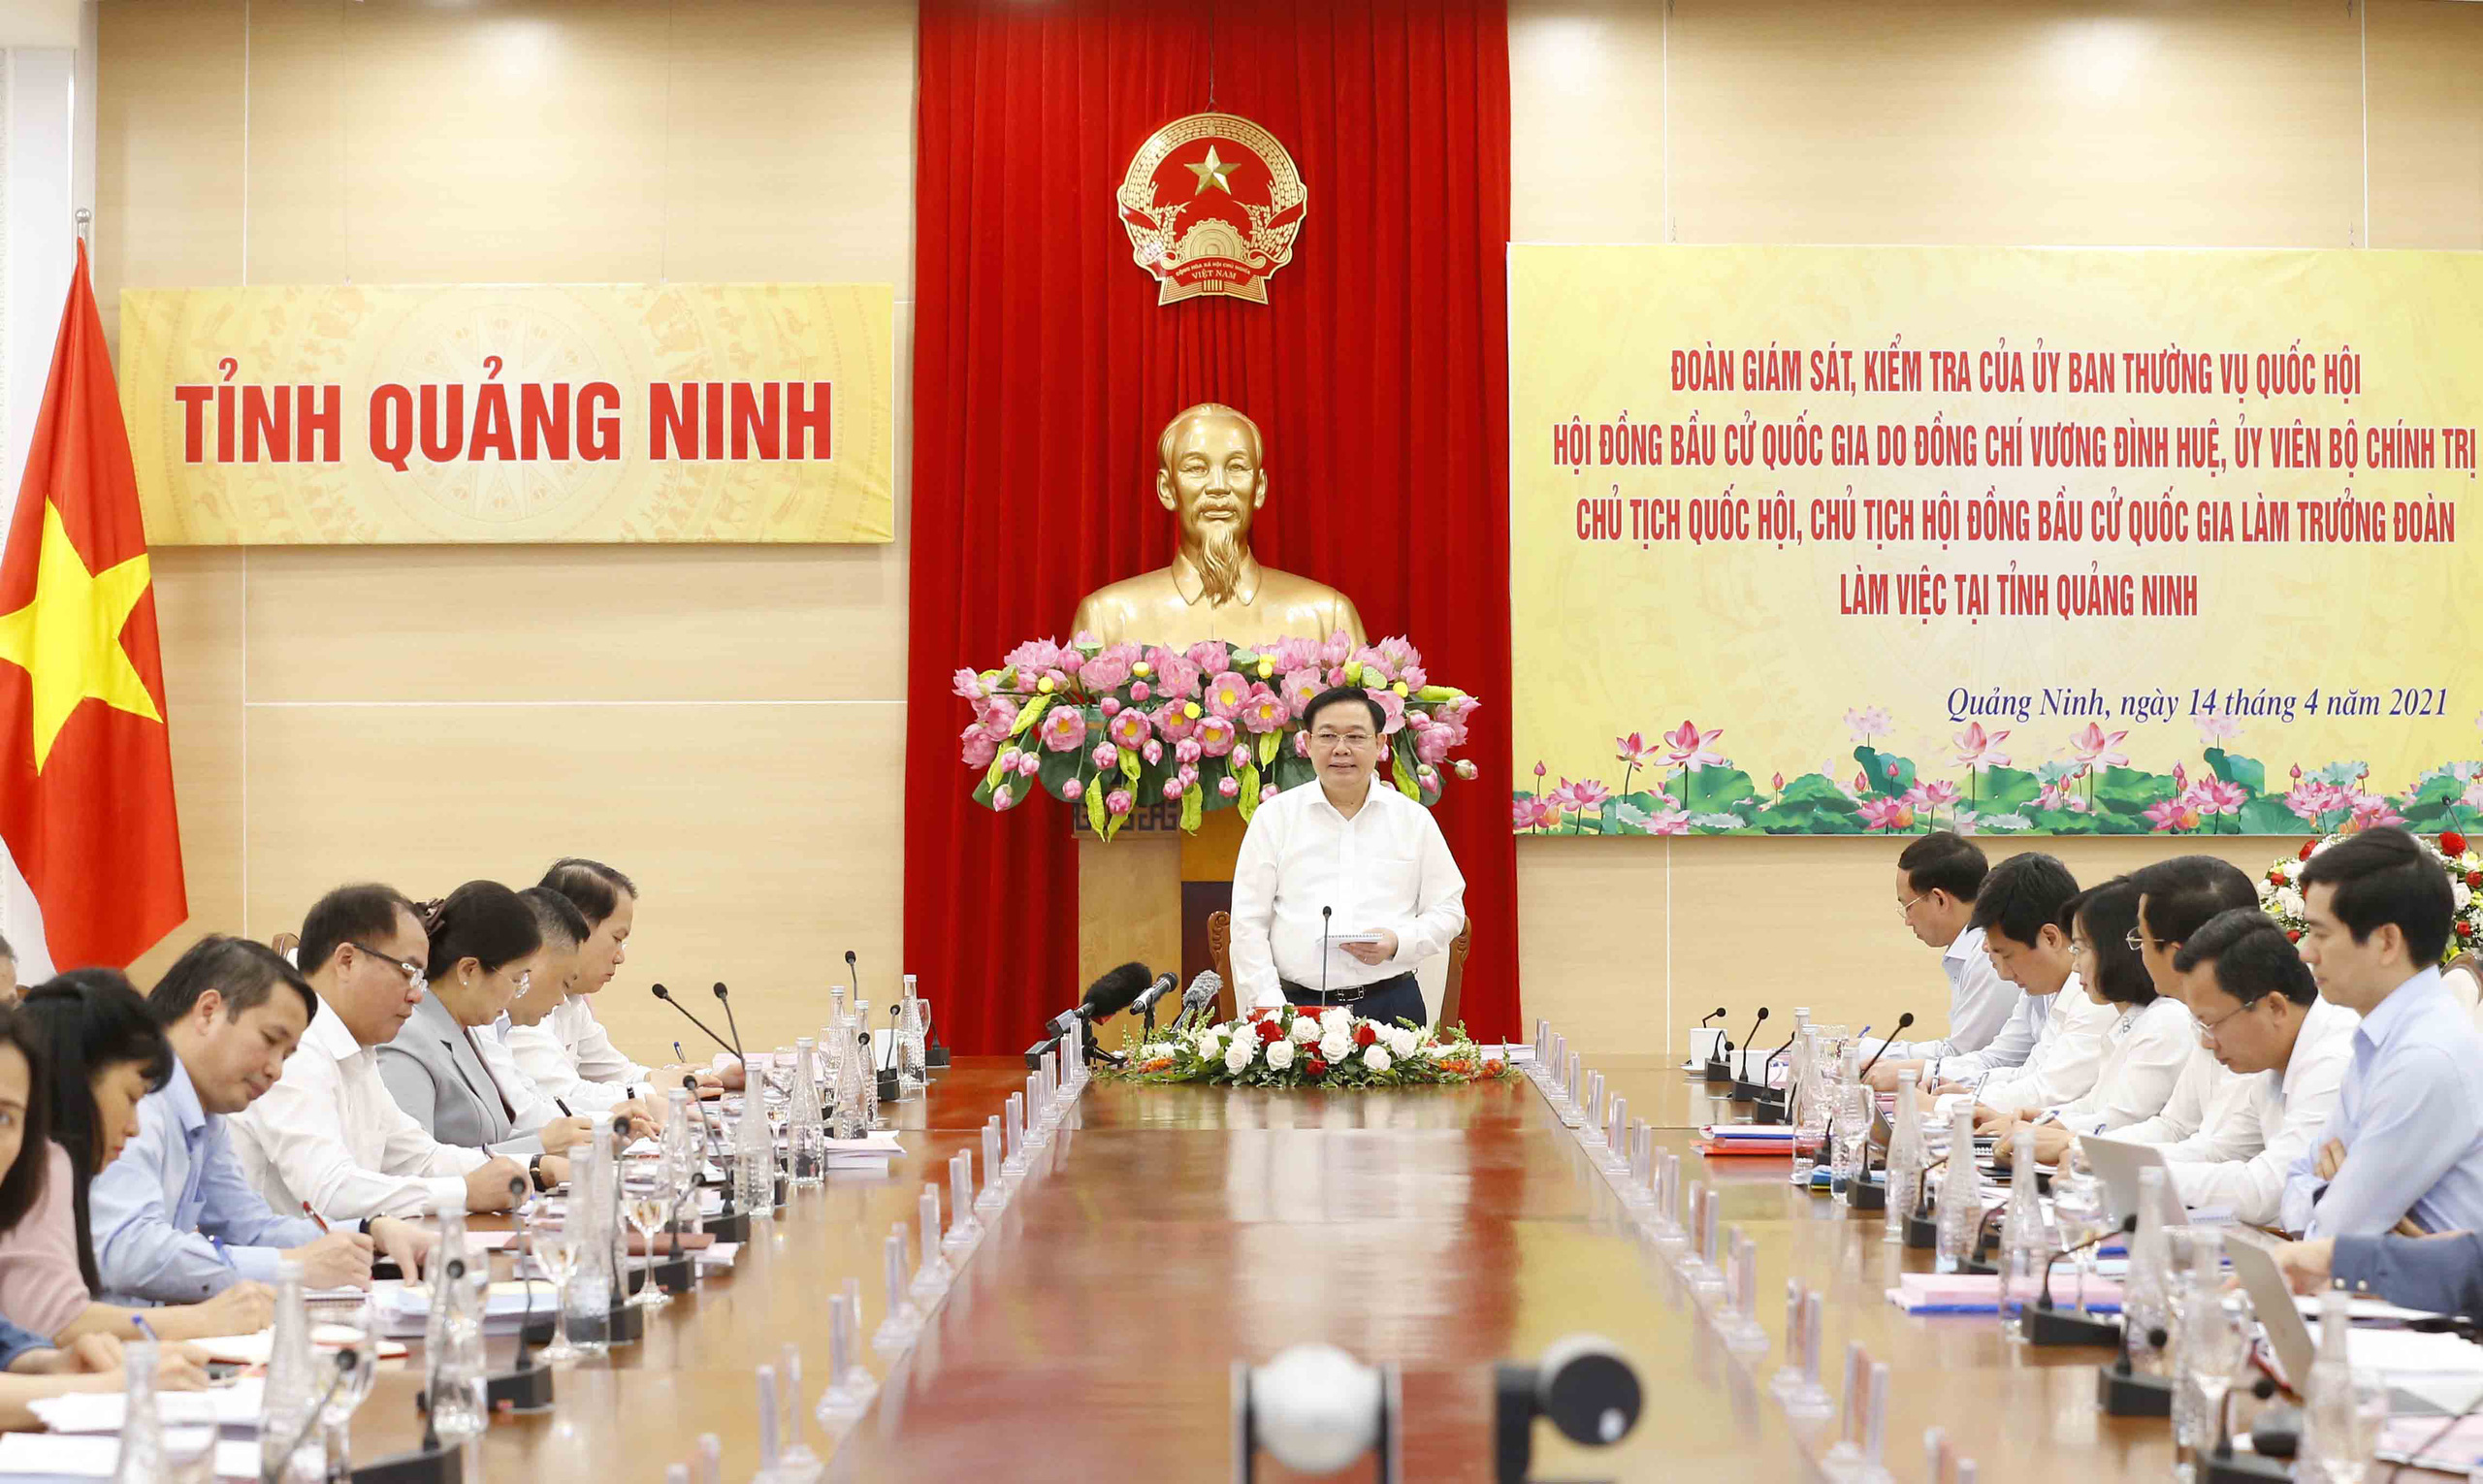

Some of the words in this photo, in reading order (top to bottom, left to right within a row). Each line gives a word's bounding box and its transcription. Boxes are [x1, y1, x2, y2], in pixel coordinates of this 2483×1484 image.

[1192, 269, 1213, 278] VIỆT
[1215, 270, 1237, 279] NAM
[1671, 341, 1735, 392] ĐOÀN
[1742, 341, 1802, 392] GIÁM
[1810, 342, 1856, 397] SÁT,
[1864, 333, 1922, 392] KIỂM
[1929, 350, 1972, 392] TRA
[1980, 337, 2025, 394] CỦA
[2032, 338, 2061, 394] ỦY
[2069, 352, 2115, 394] BAN
[2122, 342, 2212, 395] THƯỜNG
[2220, 352, 2248, 404] VỤ
[2256, 339, 2316, 399] QUỐC
[2324, 345, 2361, 404] HỘI
[174, 356, 341, 464] TỈNH
[370, 355, 622, 473] QUẢNG
[648, 381, 832, 461] NINH
[1554, 415, 1592, 475] HỘI
[1599, 410, 1662, 467] ĐỒNG
[1670, 410, 1717, 467] BẦU
[1724, 410, 1757, 467] CỬ
[1762, 409, 1823, 470] QUỐC
[1831, 424, 1870, 467] GIA
[1877, 424, 1907, 468] DO
[1915, 411, 1978, 467] ĐỒNG
[1984, 417, 2023, 468] CHÍ
[2030, 422, 2107, 468] VƯƠNG
[2113, 418, 2169, 468] ĐÌNH
[2176, 418, 2227, 478] HUỆ,
[2235, 413, 2263, 468] ỦY
[2270, 419, 2322, 468] VIÊN
[2329, 419, 2359, 478] BỘ
[2367, 419, 2435, 469] CHÍNH
[2442, 427, 2476, 478] TRỊ
[1576, 484, 1623, 541] CHỦ
[1629, 499, 1681, 550] TỊCH
[1689, 483, 1750, 545] QUỐC
[1757, 490, 1803, 550] HỘI,
[1810, 484, 1856, 541] CHỦ
[1863, 499, 1915, 550] TỊCH
[1921, 490, 1960, 550] HỘI
[1967, 485, 2030, 542] ĐỒNG
[2038, 485, 2083, 542] BẦU
[2091, 486, 2124, 542] CỬ
[2128, 486, 2189, 548] QUỐC
[2197, 500, 2235, 543] GIA
[2241, 492, 2290, 543] LÀM
[2297, 488, 2387, 543] TRƯỞNG
[2393, 493, 2456, 543] ĐOÀN
[1840, 565, 1889, 616] LÀM
[1896, 565, 1948, 626] VIỆC
[1953, 573, 1989, 626] TẠI
[1996, 560, 2049, 616] TỈNH
[2056, 560, 2135, 621] QUẢNG
[2142, 574, 2198, 617] NINH
[1947, 686, 2032, 724] Quảng
[2038, 688, 2112, 720] Ninh,
[2119, 688, 2179, 723] ngày
[2188, 688, 2217, 716] 14
[2224, 688, 2298, 723] tháng
[2304, 688, 2319, 716] 4
[2326, 689, 2380, 716] năm
[2388, 688, 2448, 716] 2021
